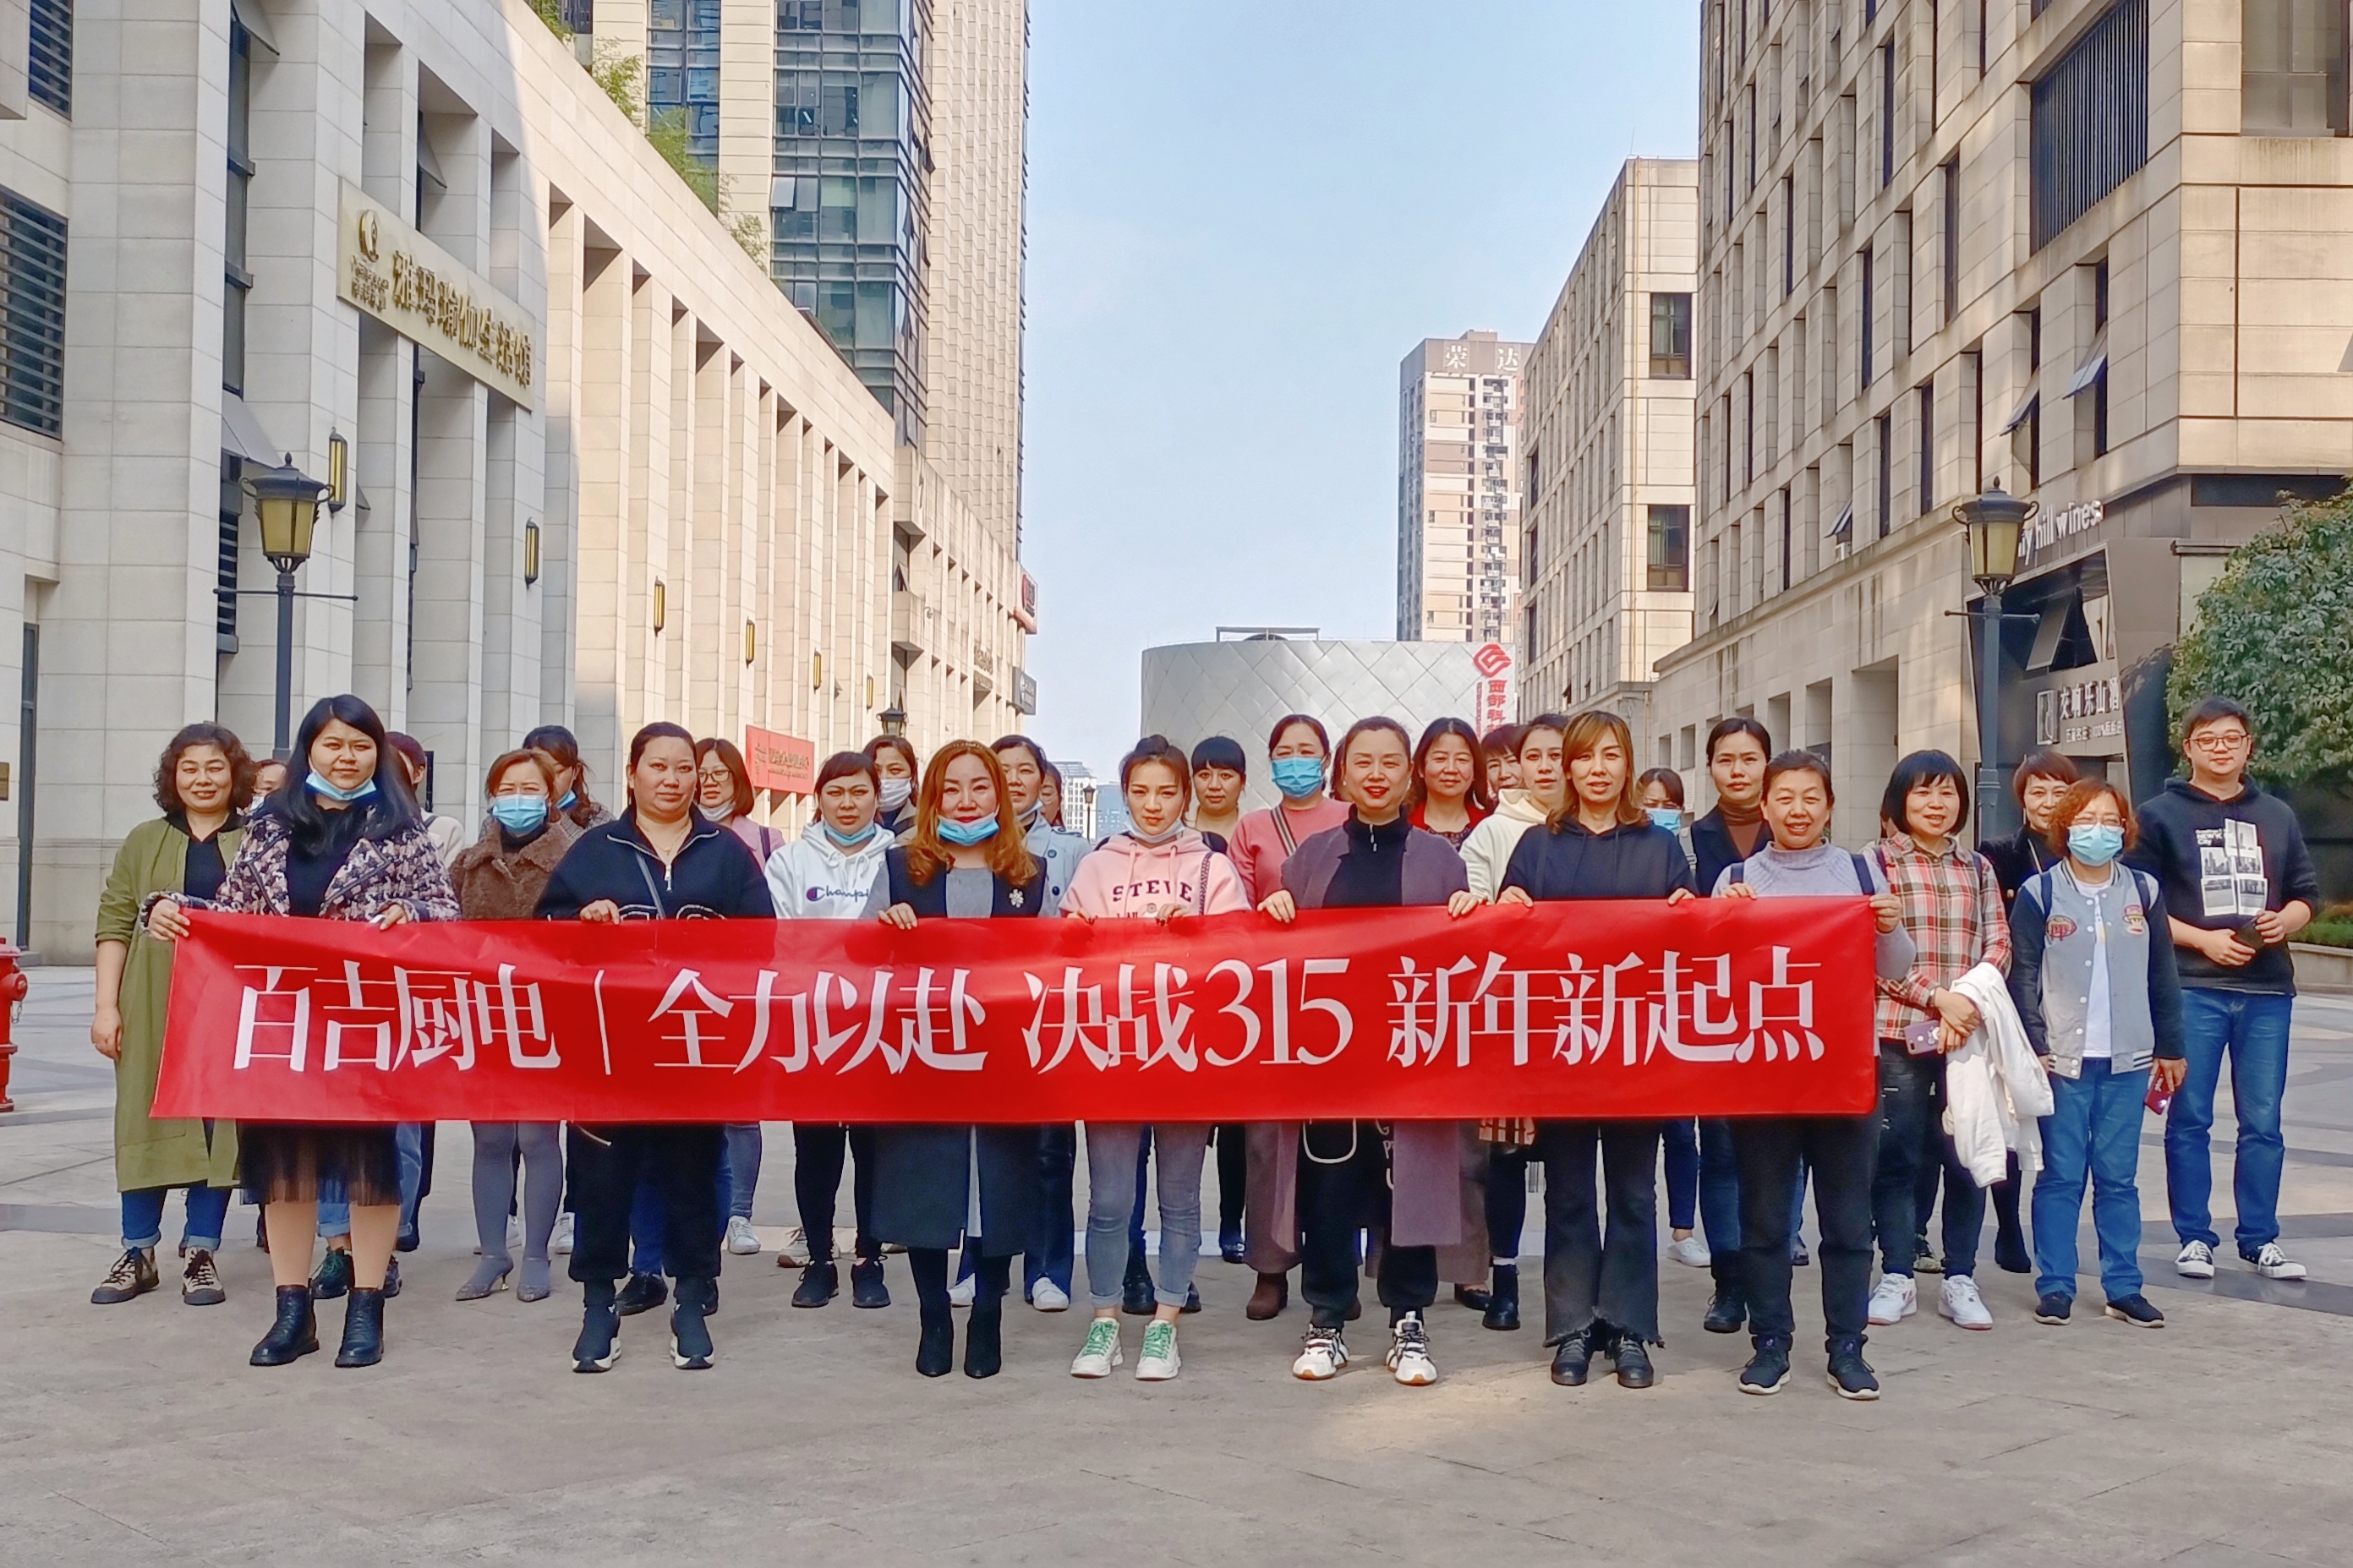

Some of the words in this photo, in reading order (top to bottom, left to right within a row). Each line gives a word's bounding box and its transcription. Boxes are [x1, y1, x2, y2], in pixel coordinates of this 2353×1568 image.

[1445, 345, 1519, 371] 荣达
[2035, 504, 2055, 550] hill
[2055, 500, 2102, 540] wines
[806, 885, 869, 903] Champi
[234, 960, 561, 1073] 百吉厨电
[649, 967, 988, 1074] 全力以赴
[1022, 958, 1354, 1074] 决战315
[1387, 945, 1825, 1068] 新年新起点
